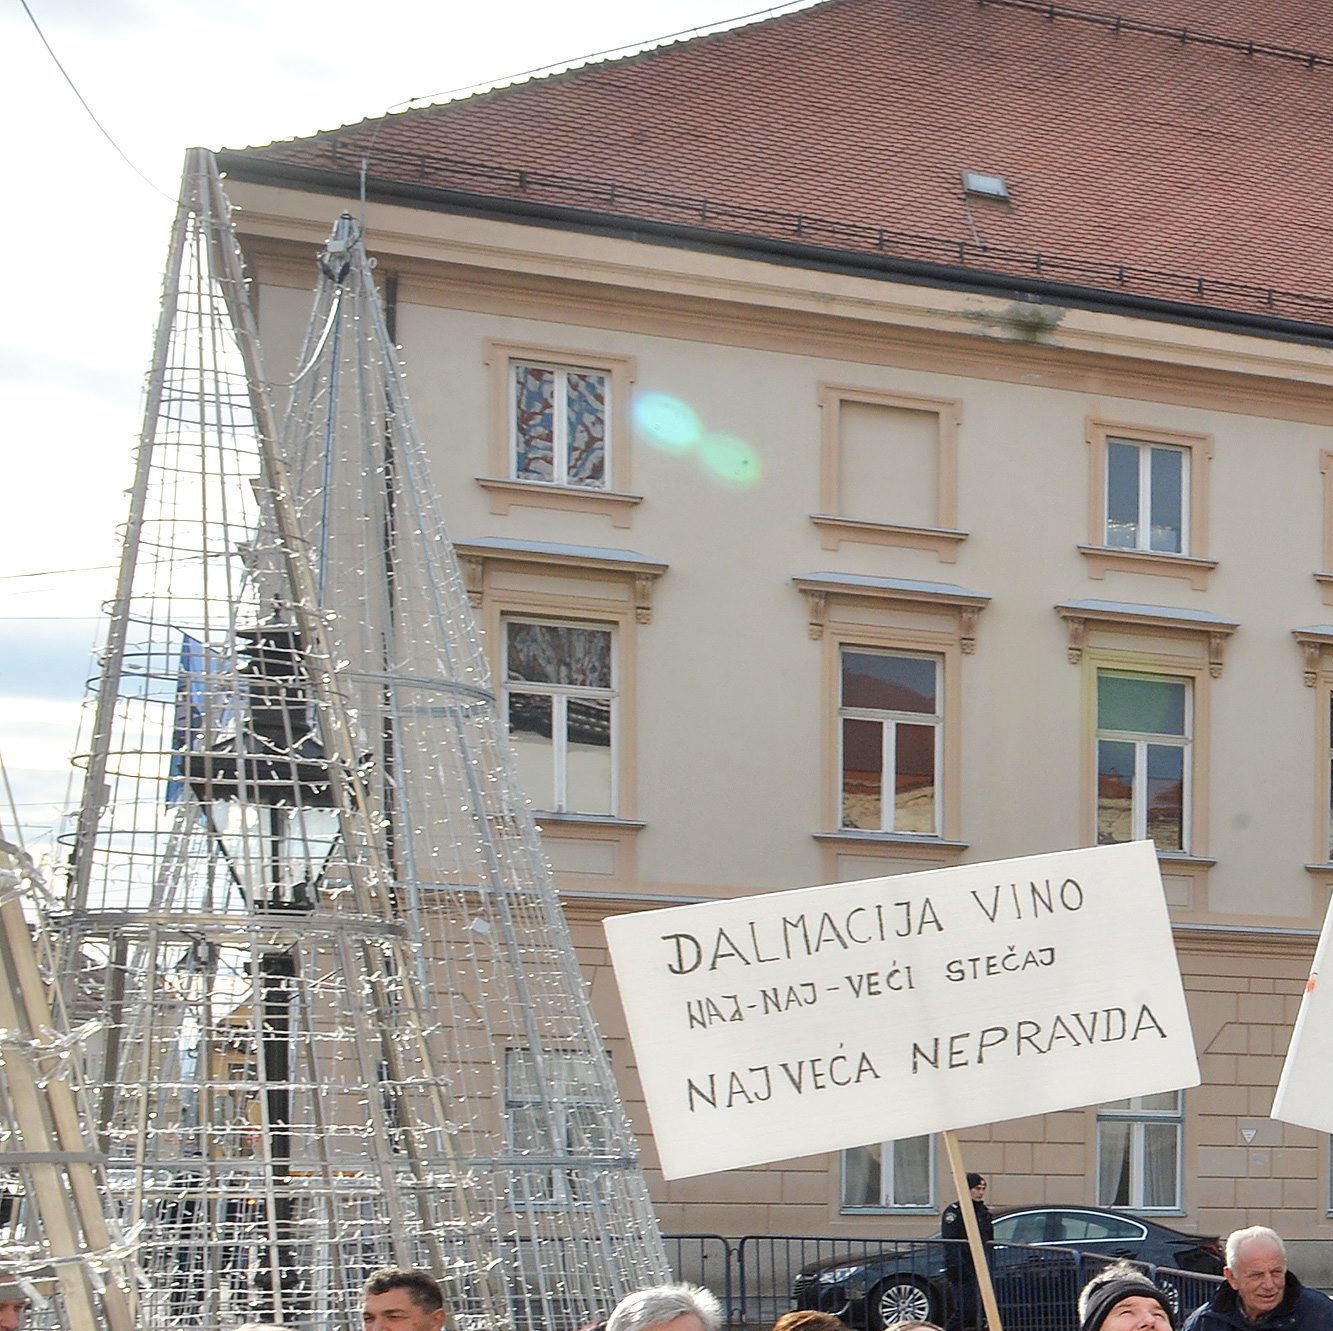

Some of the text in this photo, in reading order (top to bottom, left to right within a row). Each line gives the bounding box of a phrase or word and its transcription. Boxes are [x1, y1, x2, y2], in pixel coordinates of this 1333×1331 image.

[660, 878, 1085, 976] DALMACIJA VINO
[945, 944, 1056, 983] STEČAJ
[686, 1004, 1168, 1112] NAJVEĆA NEPRAVDA
